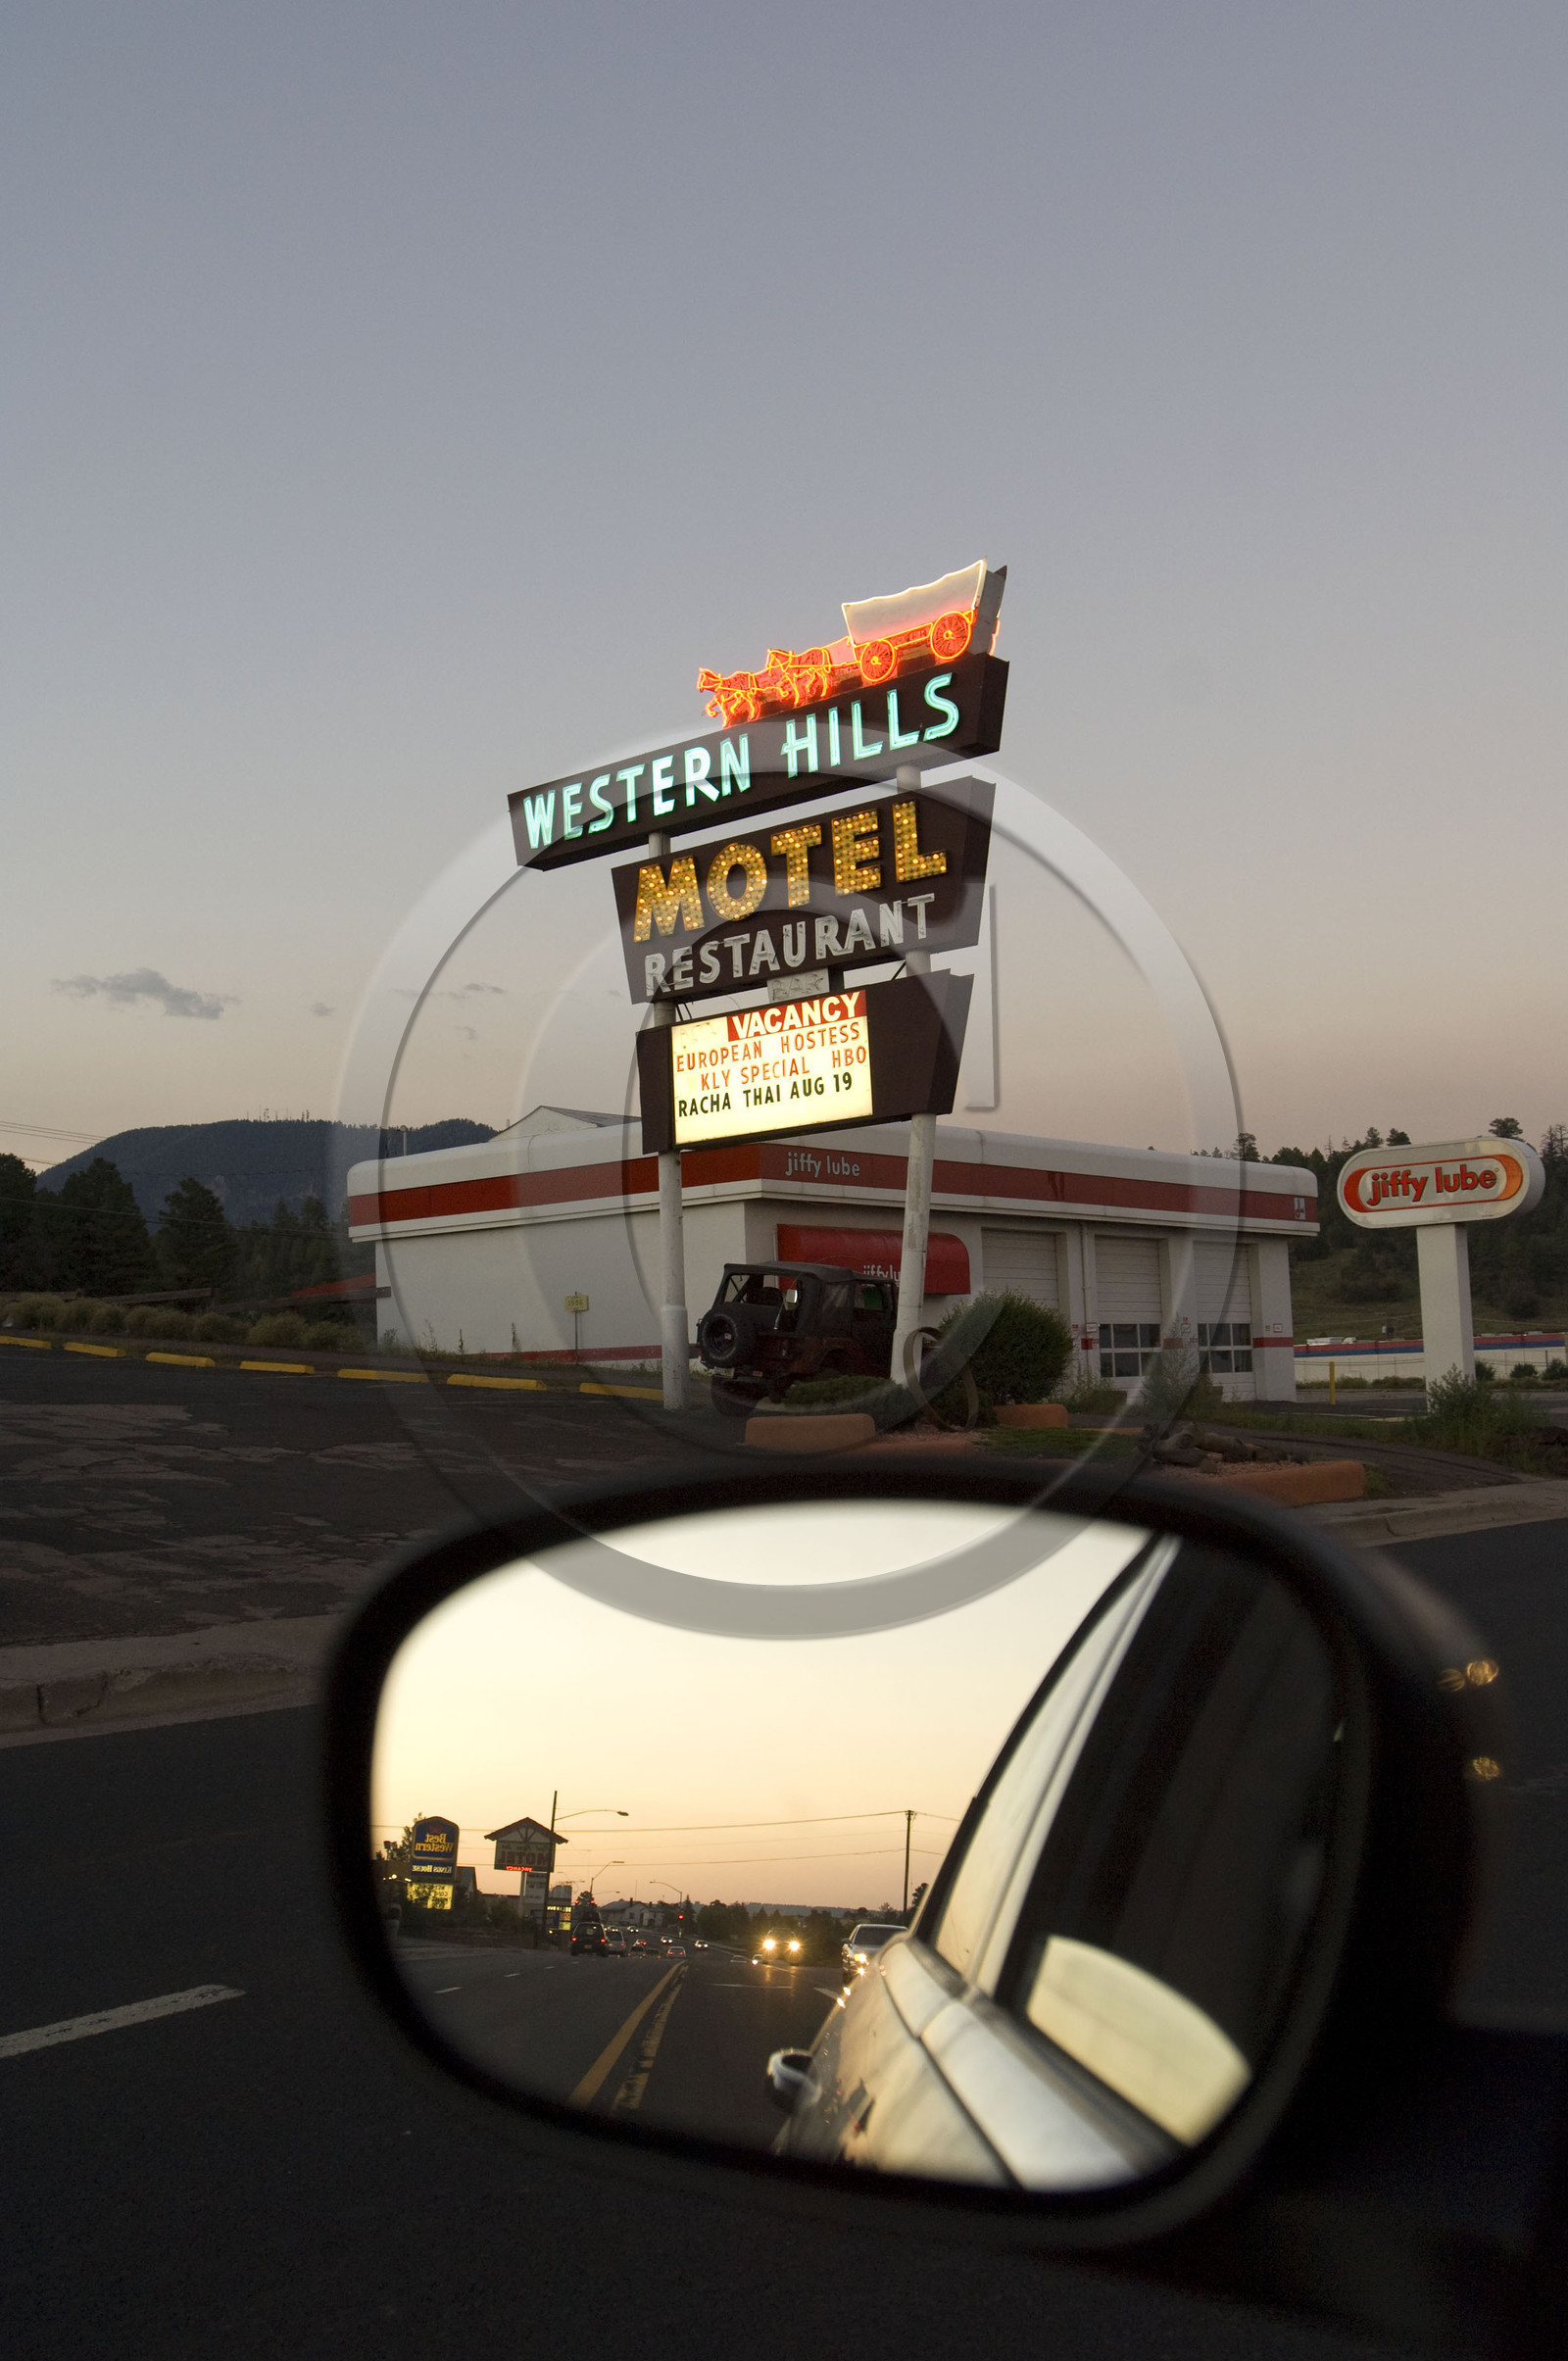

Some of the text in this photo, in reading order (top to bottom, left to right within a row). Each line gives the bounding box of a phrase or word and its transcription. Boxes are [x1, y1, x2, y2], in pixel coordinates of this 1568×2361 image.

[523, 671, 960, 850] WESTERN HILLS
[633, 799, 948, 943] MOTEL
[644, 893, 936, 997] RESTAURANT
[731, 991, 860, 1040] VACANCY
[676, 1021, 860, 1072] EUROPEAN HOSTESS
[701, 1046, 867, 1091] KLY SPECIAL HBO
[678, 1071, 853, 1117] RACHA THAI AUG 19
[785, 1152, 860, 1178] jiffy lube
[1366, 1164, 1497, 1206] jiffy lube
